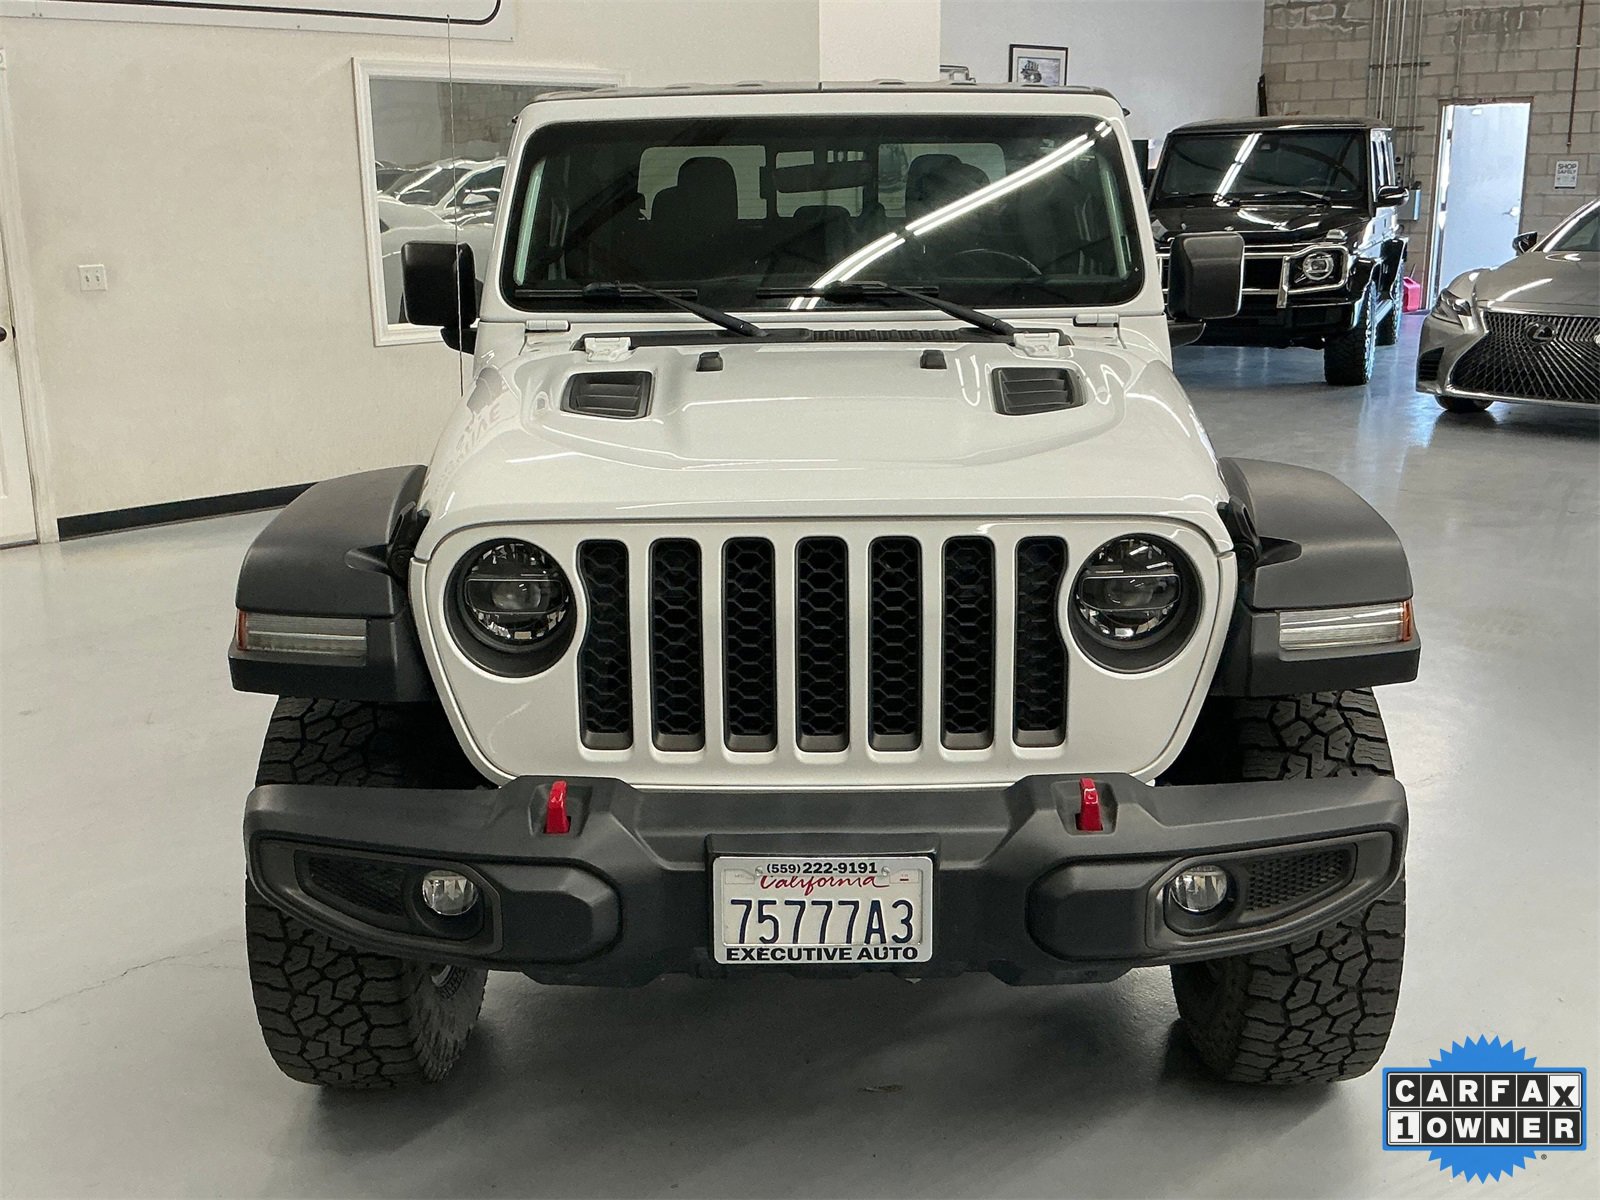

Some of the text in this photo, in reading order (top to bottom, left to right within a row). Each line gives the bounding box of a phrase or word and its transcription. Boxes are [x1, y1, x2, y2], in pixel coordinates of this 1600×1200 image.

[766, 862, 878, 874] (559) 222-9191
[759, 875, 891, 896] California
[730, 899, 914, 944] 75777A3
[726, 946, 918, 961] EXECUTIVE AUTO
